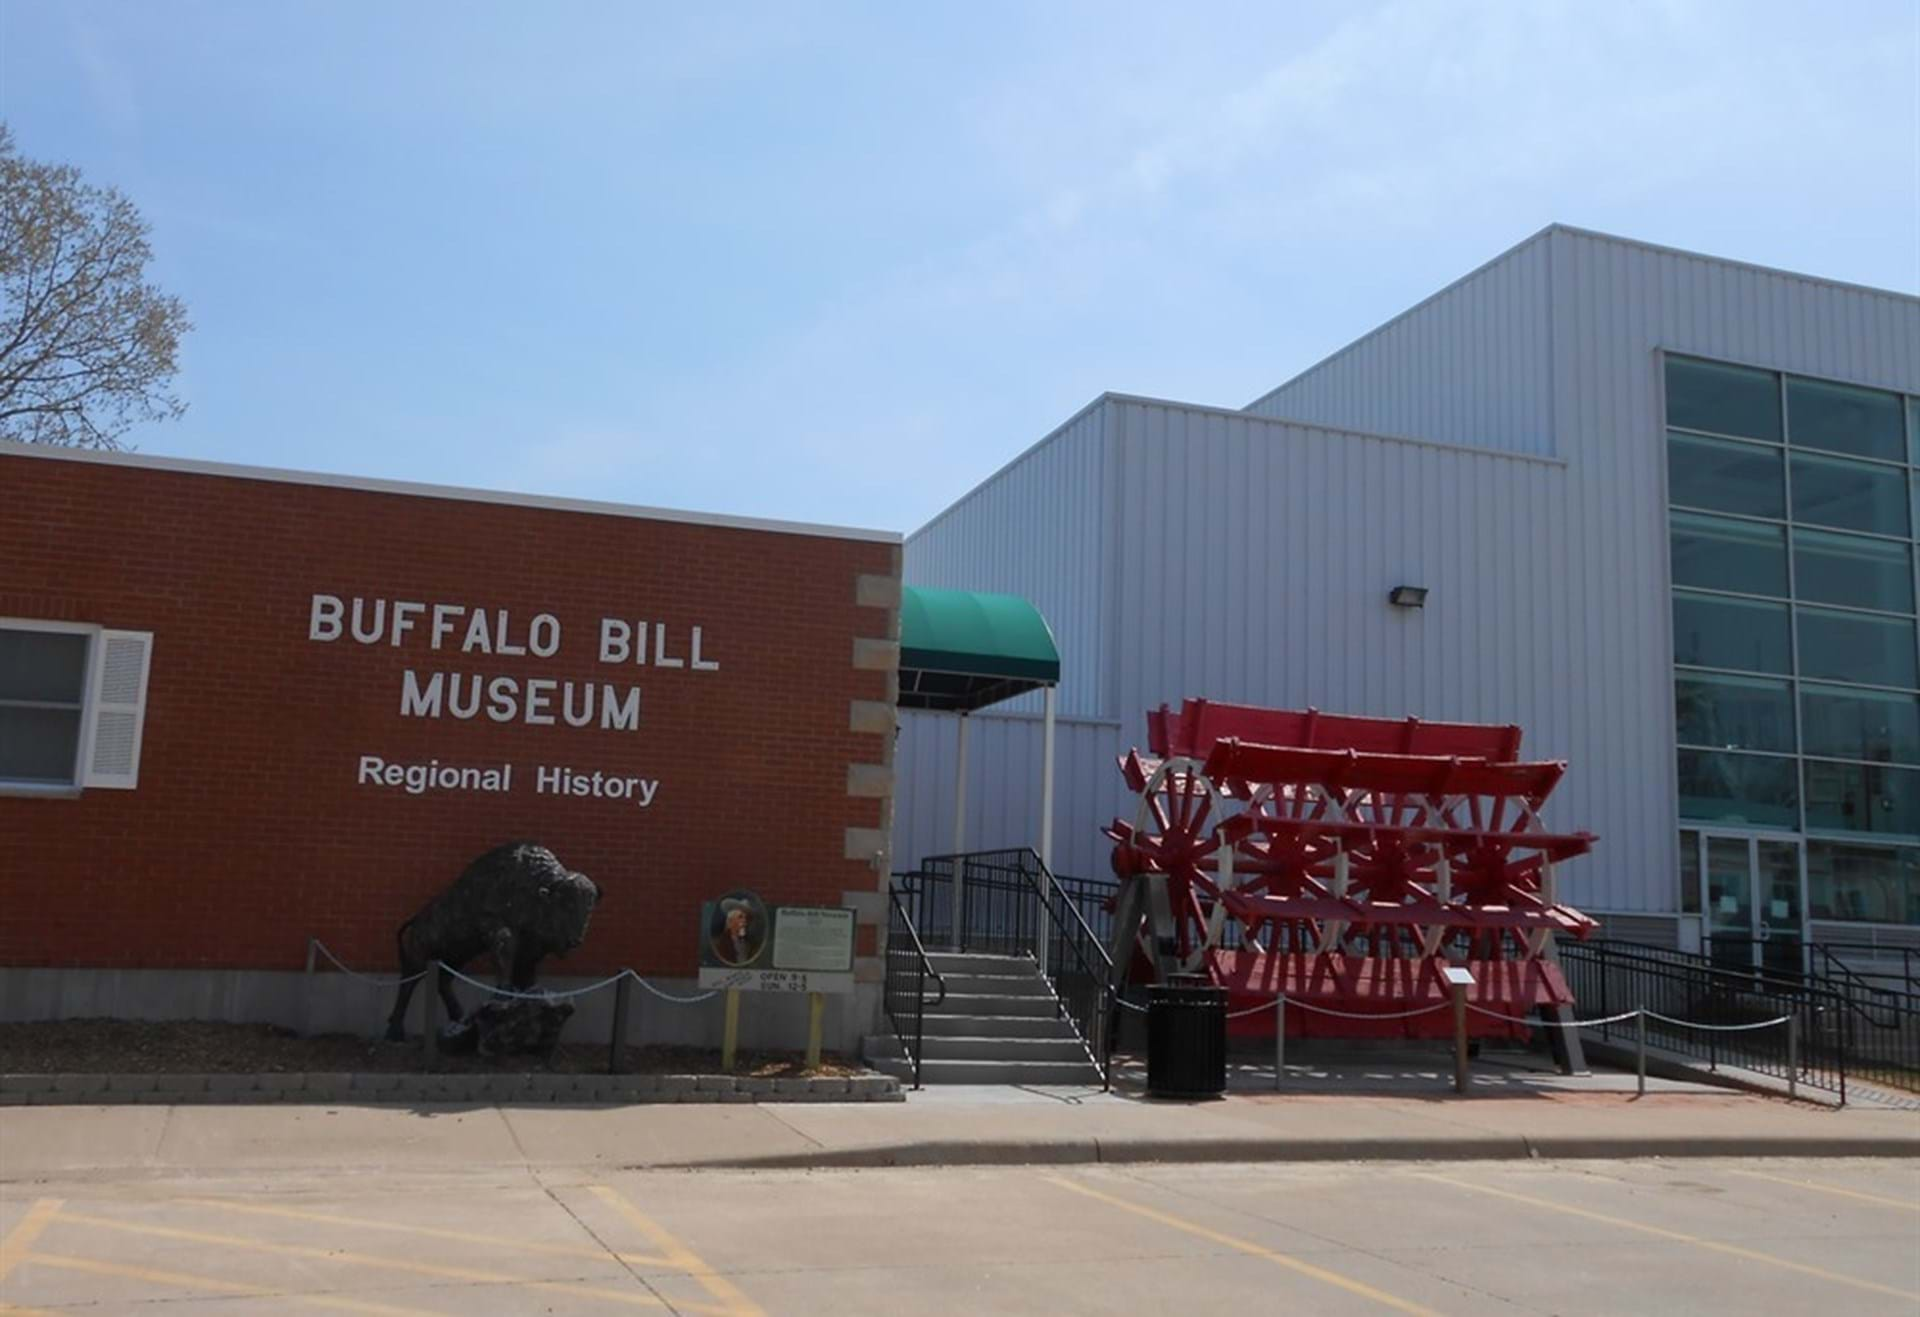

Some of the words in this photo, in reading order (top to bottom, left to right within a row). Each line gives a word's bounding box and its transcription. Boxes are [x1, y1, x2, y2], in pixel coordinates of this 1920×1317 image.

[309, 595, 560, 658] BUFFALO
[599, 618, 719, 670] BILL
[401, 671, 641, 730] MUSEUM
[358, 757, 511, 793] Regional
[537, 766, 658, 806] History
